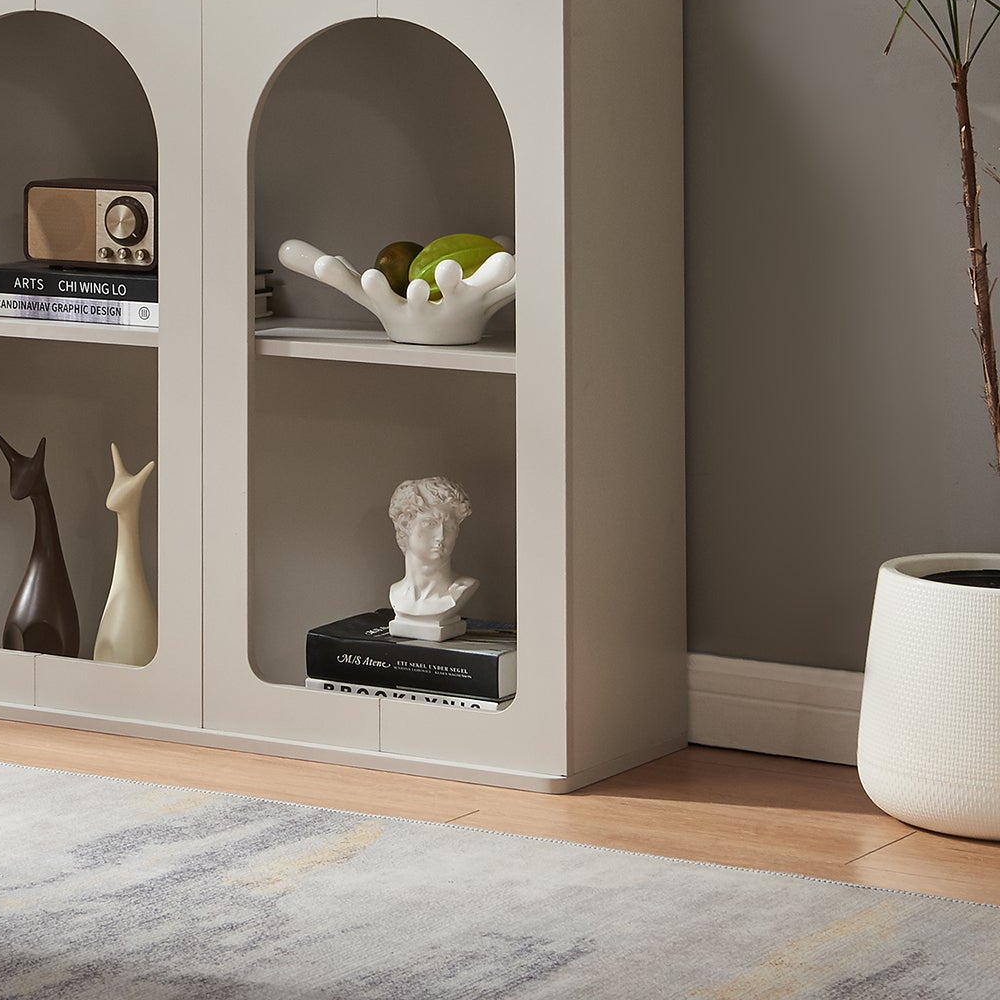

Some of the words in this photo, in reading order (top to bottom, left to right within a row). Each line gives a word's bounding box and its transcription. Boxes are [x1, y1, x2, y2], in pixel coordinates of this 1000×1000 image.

[13, 277, 44, 291] ARTS
[58, 279, 77, 293] CHI
[79, 280, 110, 295] WING
[112, 283, 127, 296] LO
[51, 301, 89, 315] GRAPHIC
[90, 304, 122, 317] DESIGN
[336, 653, 361, 665] M/S
